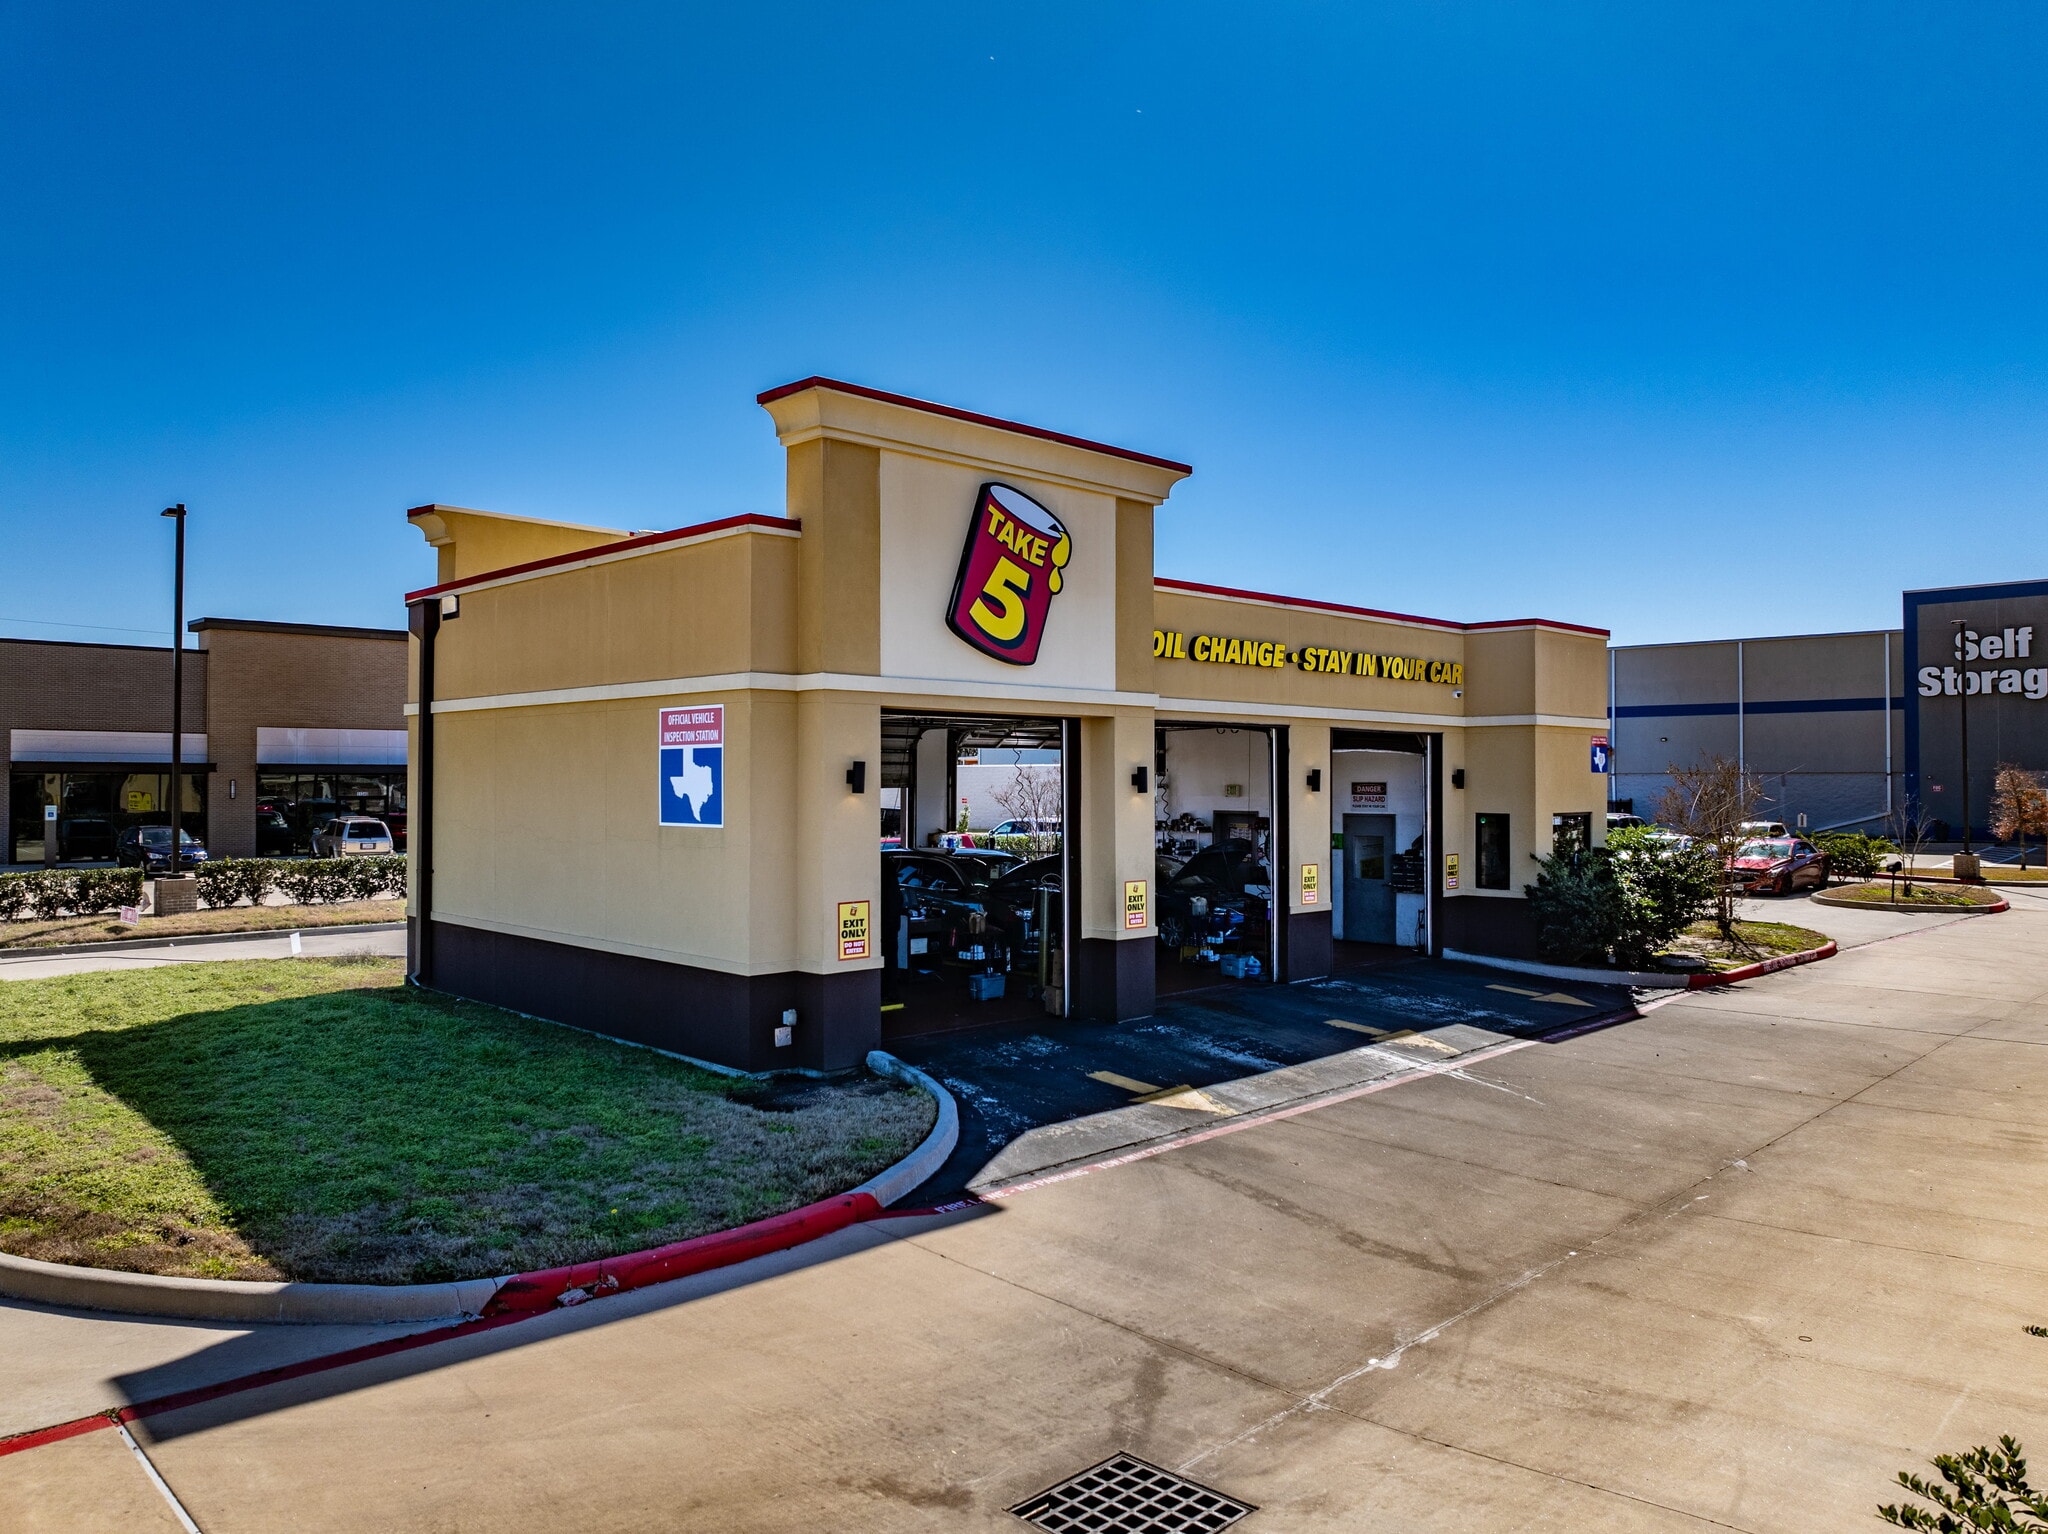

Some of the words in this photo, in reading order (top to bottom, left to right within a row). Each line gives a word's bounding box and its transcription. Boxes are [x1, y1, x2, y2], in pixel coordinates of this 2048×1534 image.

[988, 504, 1049, 567] TAKE
[969, 555, 1031, 641] 5
[1954, 626, 2033, 661] Self
[1153, 630, 1186, 659] OIL
[1192, 635, 1286, 668] CHANGE
[1302, 647, 1351, 674] STAY
[1356, 653, 1377, 676] IN
[1381, 655, 1427, 681] YOUR
[1430, 661, 1463, 685] CAR
[668, 714, 691, 726] OFFICIAL
[691, 712, 715, 724] VEHICLE
[663, 731, 695, 743] INSPECTION
[695, 729, 719, 741] STATION
[1128, 895, 1143, 903] EXIT
[1127, 903, 1145, 911] ONLY
[843, 918, 865, 928] EXIT
[841, 928, 867, 939] ONLY
[934, 1200, 971, 1214] FIRE
